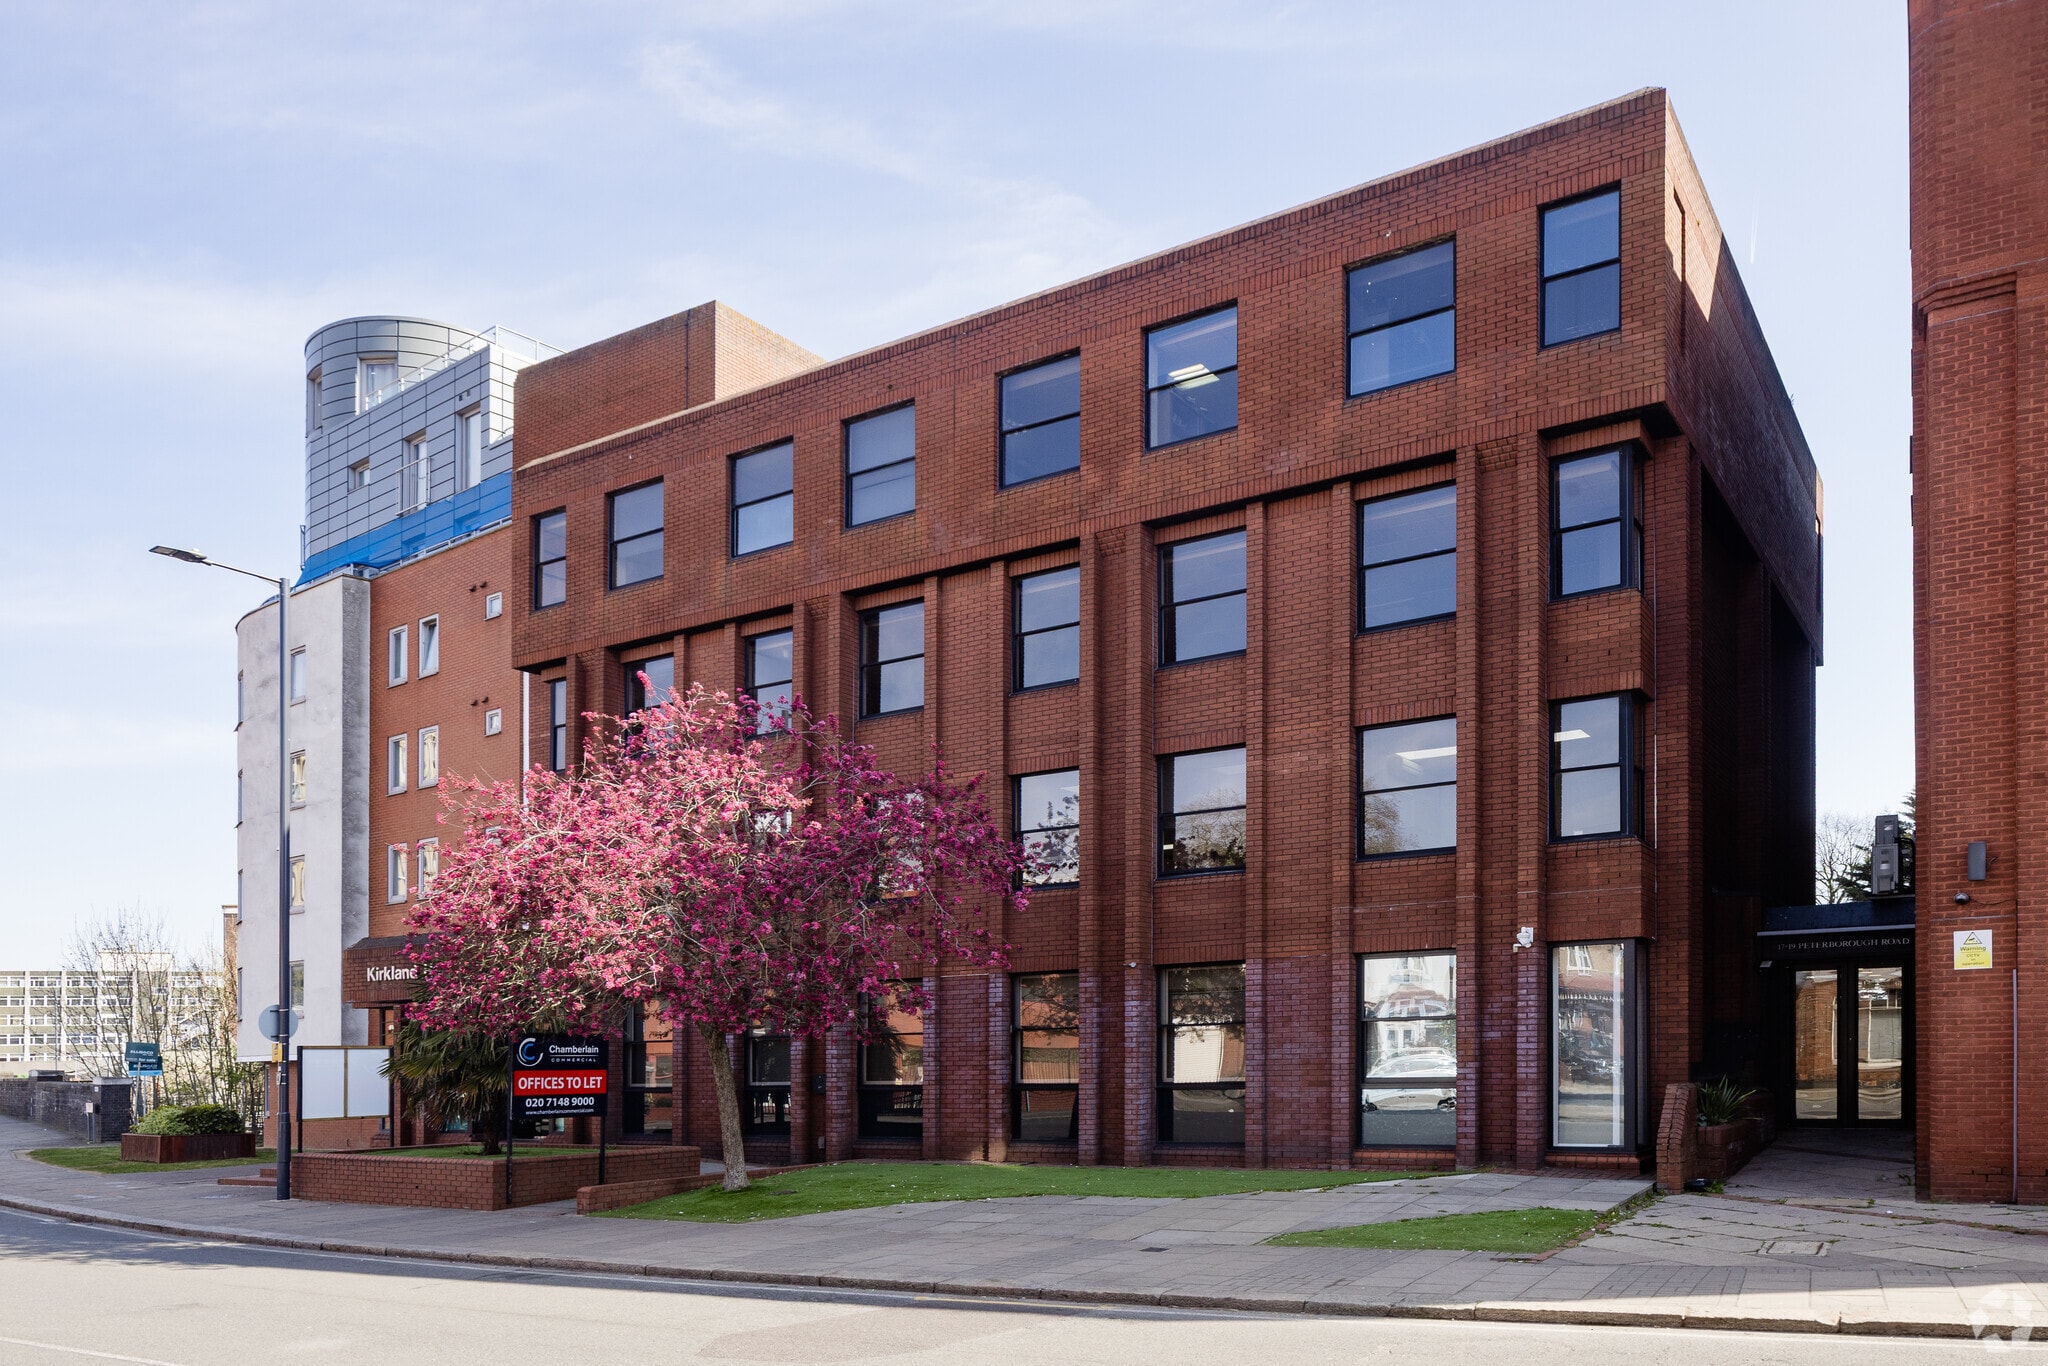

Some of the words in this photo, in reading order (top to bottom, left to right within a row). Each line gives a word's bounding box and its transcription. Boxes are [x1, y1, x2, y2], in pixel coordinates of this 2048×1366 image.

[1798, 938, 1878, 949] PETERBOROUGH
[1881, 937, 1910, 946] ROAD
[548, 1044, 599, 1054] Chamberlain
[518, 1077, 565, 1090] OFFICES
[566, 1076, 581, 1089] TO
[583, 1076, 603, 1089] LET
[525, 1098, 544, 1108] 020
[546, 1098, 570, 1107] 7148
[571, 1097, 595, 1106] 9000
